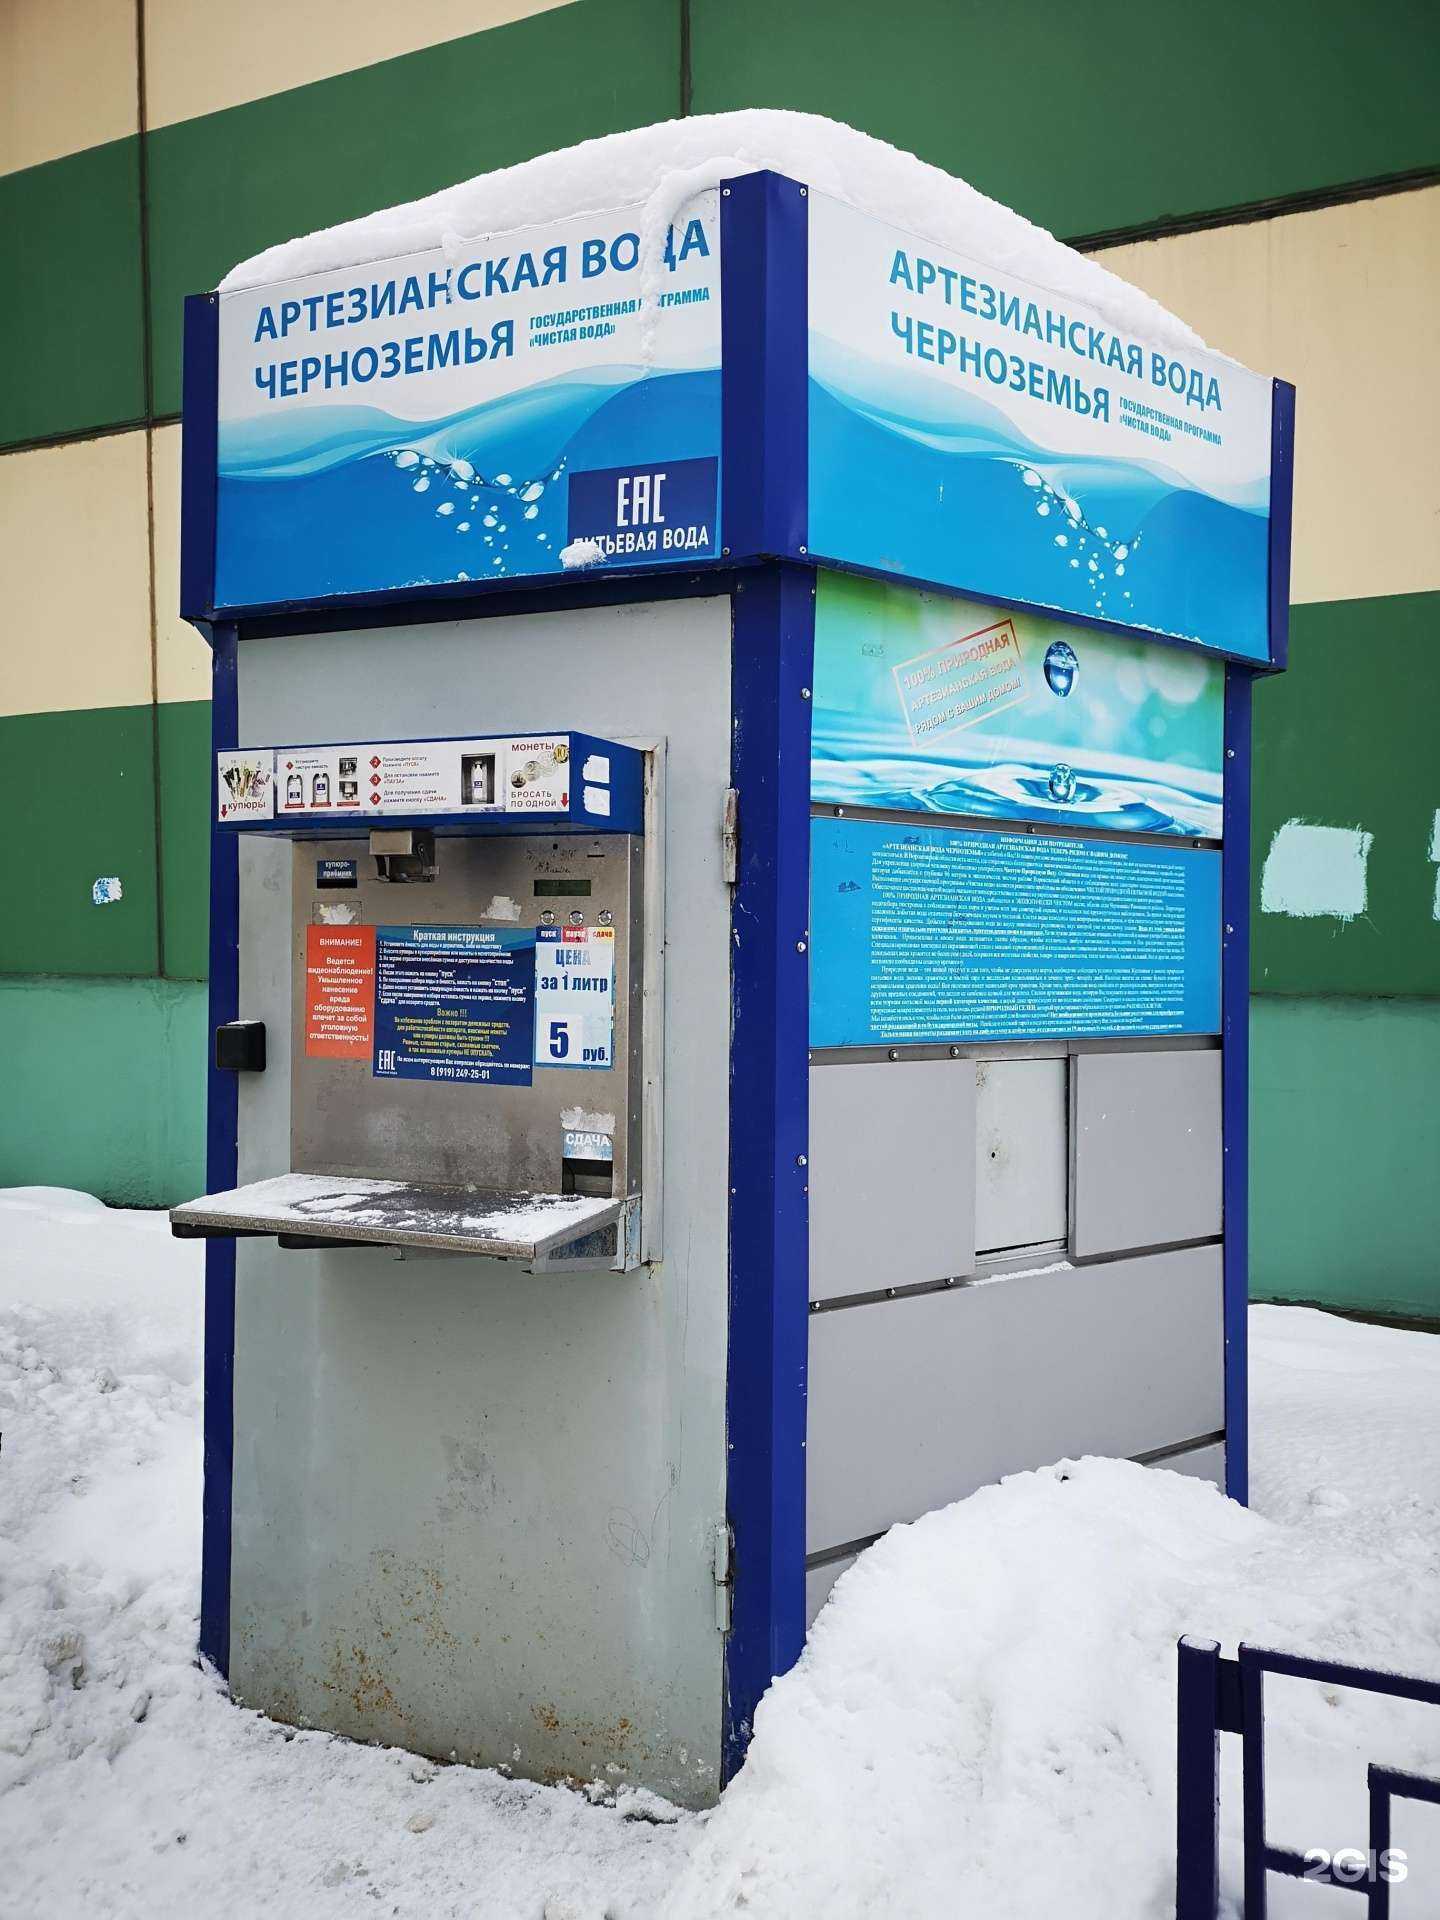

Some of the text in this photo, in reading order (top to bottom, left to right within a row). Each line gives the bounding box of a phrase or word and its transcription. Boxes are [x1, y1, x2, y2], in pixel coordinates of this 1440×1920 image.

[254, 246, 567, 343] АРТЕЗИАНСКАЯ
[530, 299, 636, 330] ГОСУДАРСТВЕННАЯ
[530, 322, 616, 347] «ЧИСТАЯ ВОДА»
[889, 249, 1222, 411] АРТЕЗИАНСКАЯ ВОДА
[254, 319, 515, 399] ЧЕРНОЗЕМЬЯ
[891, 311, 1109, 423] ЧЕРНОЗЕМЬЯ
[1120, 396, 1222, 446] ГОСУДАРСТВЕННАЯ ПРОГРАММА
[663, 525, 709, 550] ВОДА
[904, 633, 1010, 689] 100% ПРИРОДНАЯ
[911, 658, 1017, 712] АРТЕЗИАНСКАЯ ВОДА
[914, 711, 948, 734] РЯДОМ
[956, 694, 989, 716] ВАШИМ
[511, 742, 555, 752] монеты
[511, 791, 553, 799] БРОСАТЬ
[228, 800, 266, 813] купюры
[511, 799, 557, 808] ПО ОДНОЙ
[413, 930, 496, 945] Краткая инструкция
[540, 930, 558, 939] пуск
[319, 938, 362, 947] ВНИМАНИЕ!
[326, 957, 355, 965] Ведется
[555, 948, 592, 968] ЦЕНА
[307, 967, 373, 975] видеонаблюдение!
[318, 975, 364, 984] Умышленное
[541, 973, 608, 993] за 1 литр
[322, 986, 359, 994] нанесение
[329, 996, 351, 1004] вреда
[314, 1004, 366, 1014] оборудованию
[436, 1008, 459, 1017] Важно
[312, 1013, 367, 1023] влечет за собой
[320, 1023, 359, 1033] уголовную
[309, 1031, 369, 1042] ответственность!
[549, 1021, 569, 1059] 5
[582, 1047, 609, 1061] руб.
[430, 1067, 490, 1079] 8 (919) 249-25-01
[565, 1133, 612, 1148] СДАЧА
